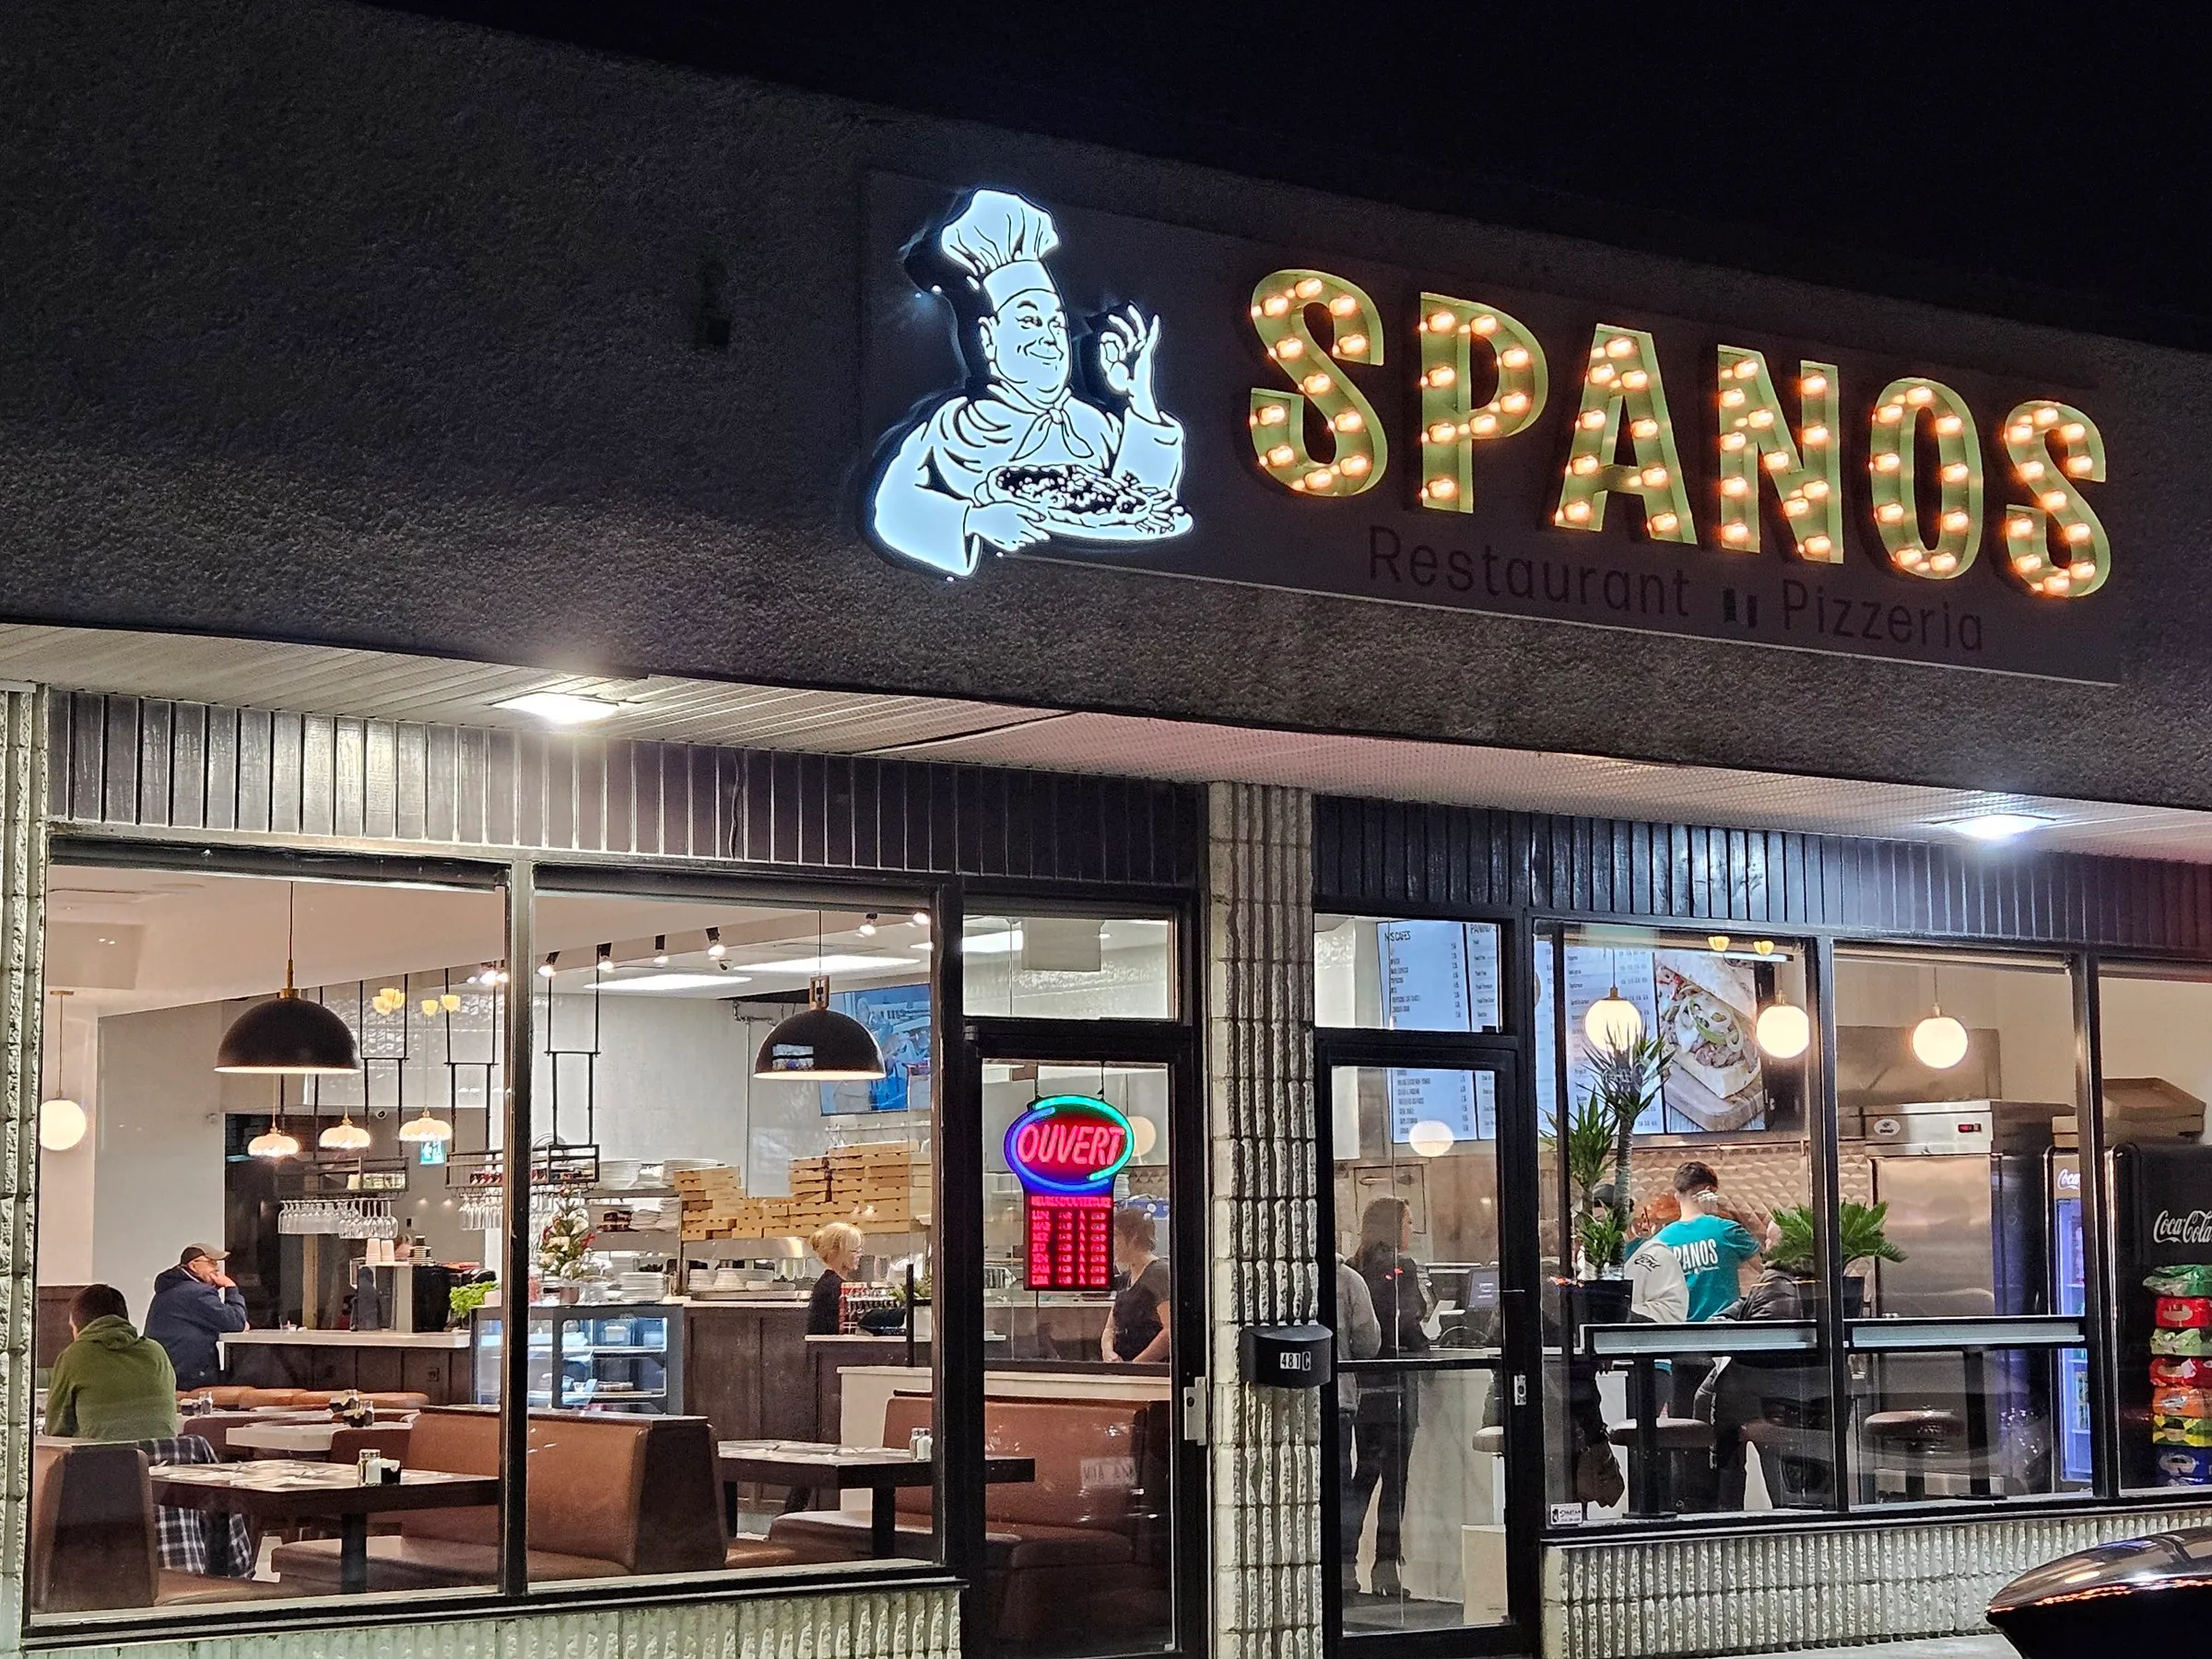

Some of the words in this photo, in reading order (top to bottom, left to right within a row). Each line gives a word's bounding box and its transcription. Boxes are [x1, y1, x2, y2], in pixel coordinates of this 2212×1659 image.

[1249, 267, 2112, 599] SPANOS
[1368, 524, 1690, 618] Restaurant
[1782, 578, 1983, 651] Pizzeria
[1017, 1123, 1125, 1166] OUVERT
[2153, 1209, 2212, 1244] Coca-Cola
[1672, 1238, 1719, 1270] PANOS
